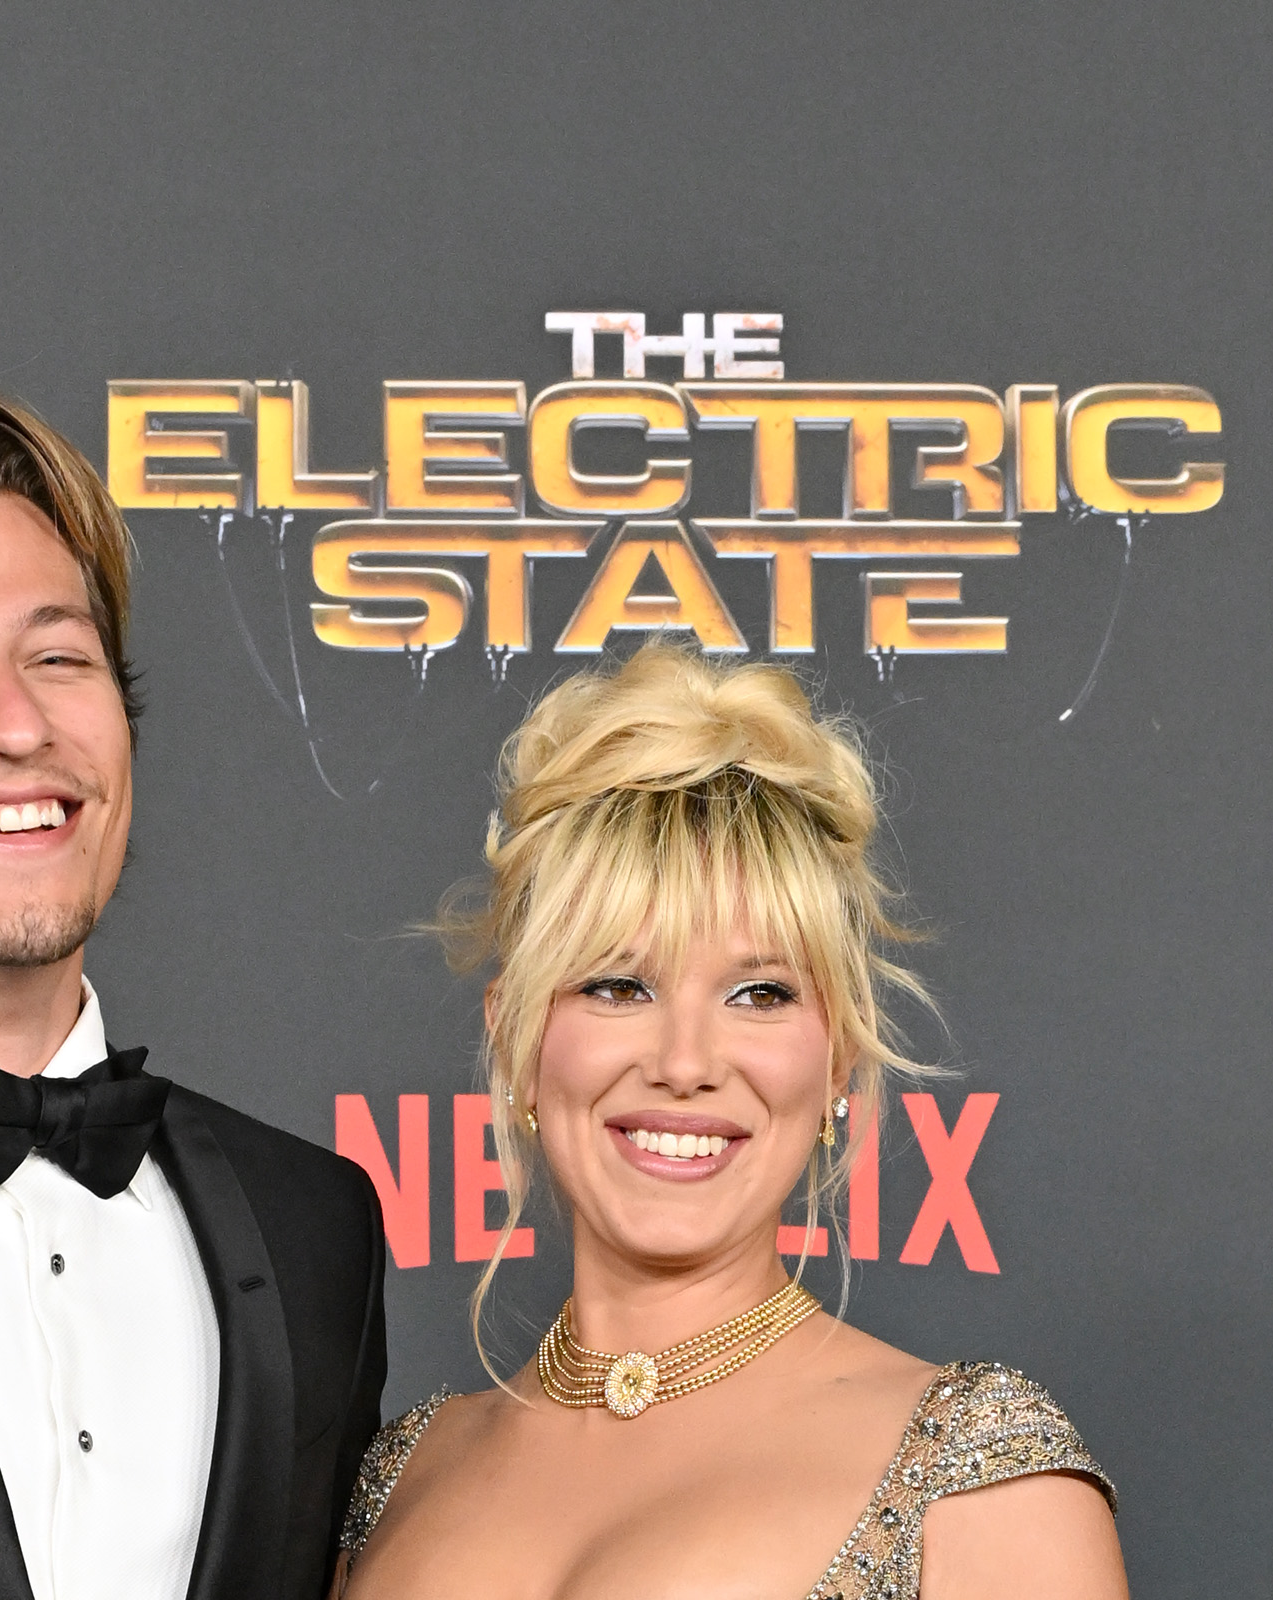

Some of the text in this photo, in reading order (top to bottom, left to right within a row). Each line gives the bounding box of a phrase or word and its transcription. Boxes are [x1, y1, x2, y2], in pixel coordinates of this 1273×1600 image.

[545, 311, 785, 379] THE
[106, 378, 1226, 519] ELECTRIC
[309, 517, 1022, 655] STATE
[335, 1093, 1001, 1275] NEIX
